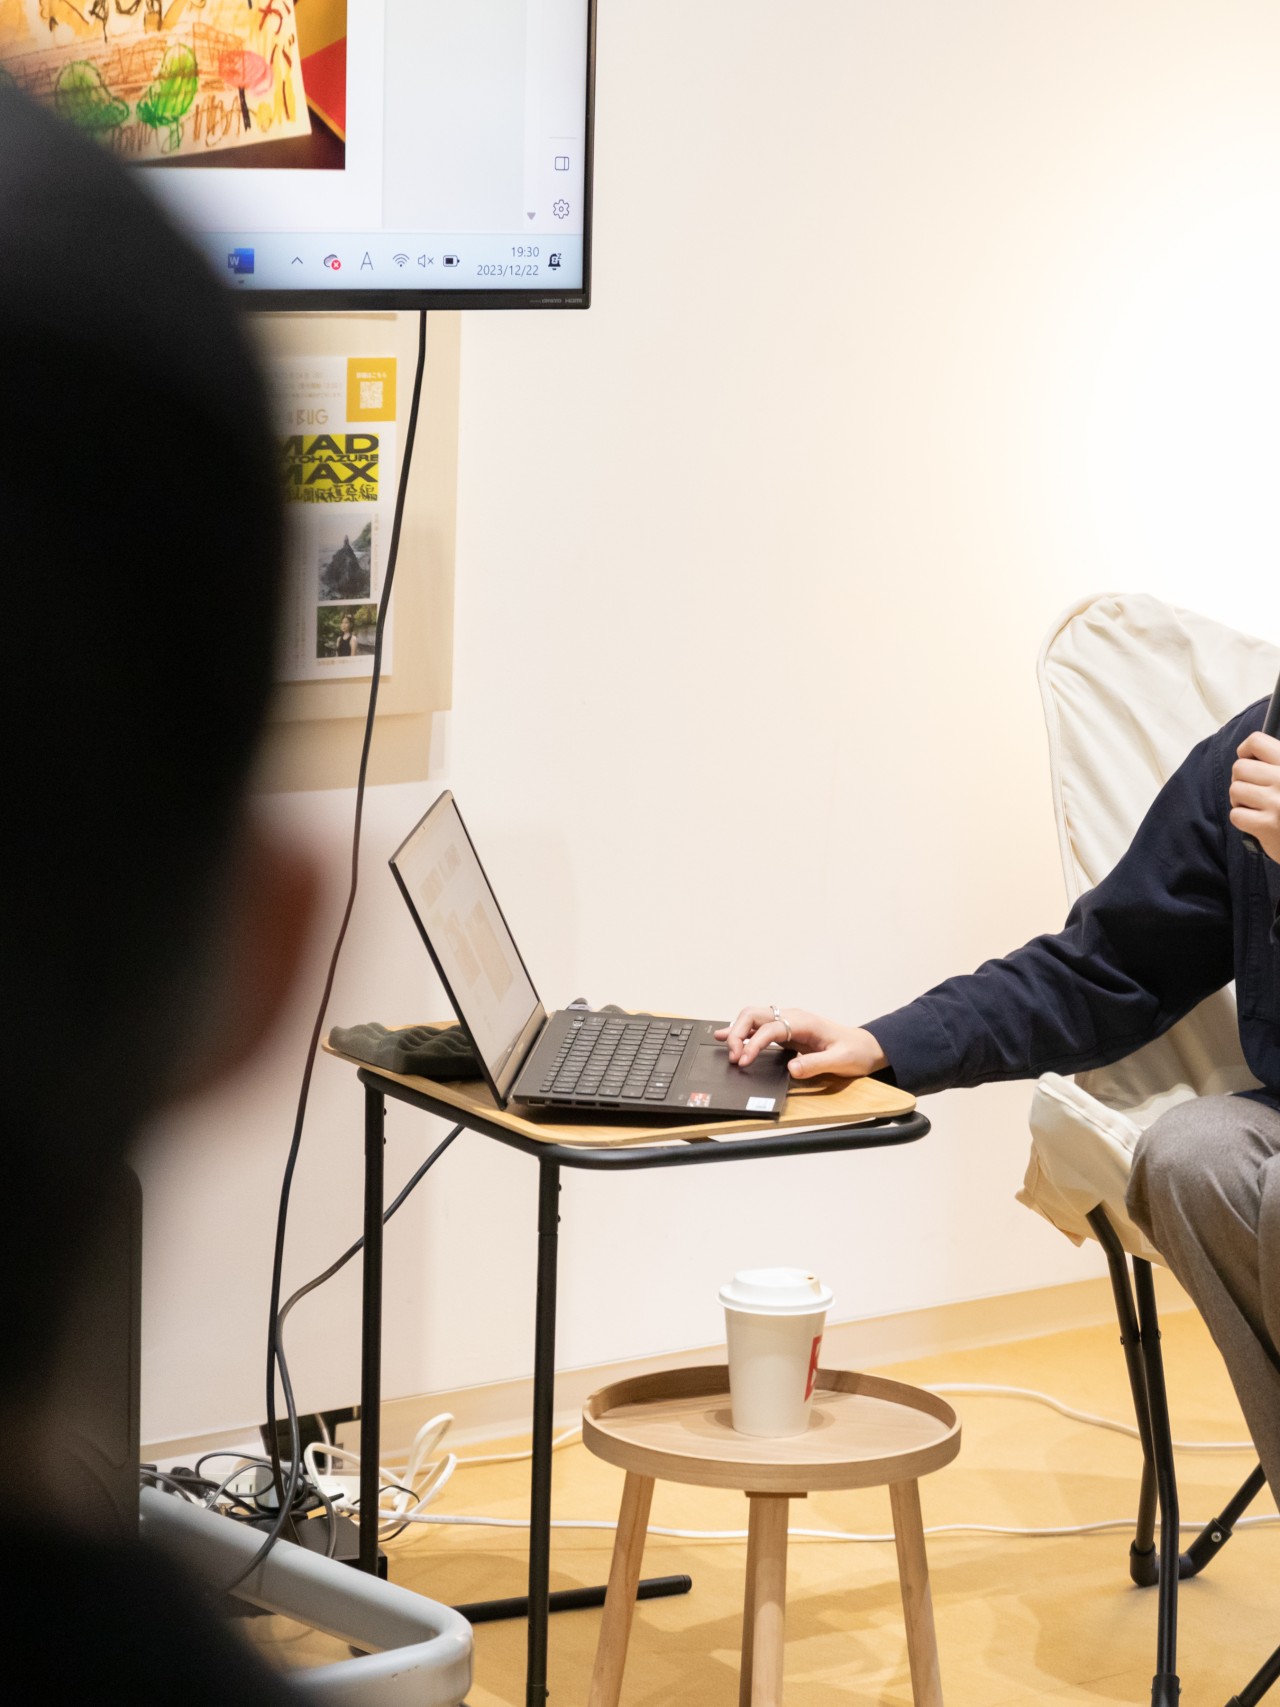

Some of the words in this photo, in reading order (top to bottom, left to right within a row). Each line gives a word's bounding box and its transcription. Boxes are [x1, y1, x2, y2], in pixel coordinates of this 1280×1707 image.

[511, 246, 540, 258] 19:30
[476, 264, 539, 277] 2023/12/22
[281, 433, 379, 455] MAD
